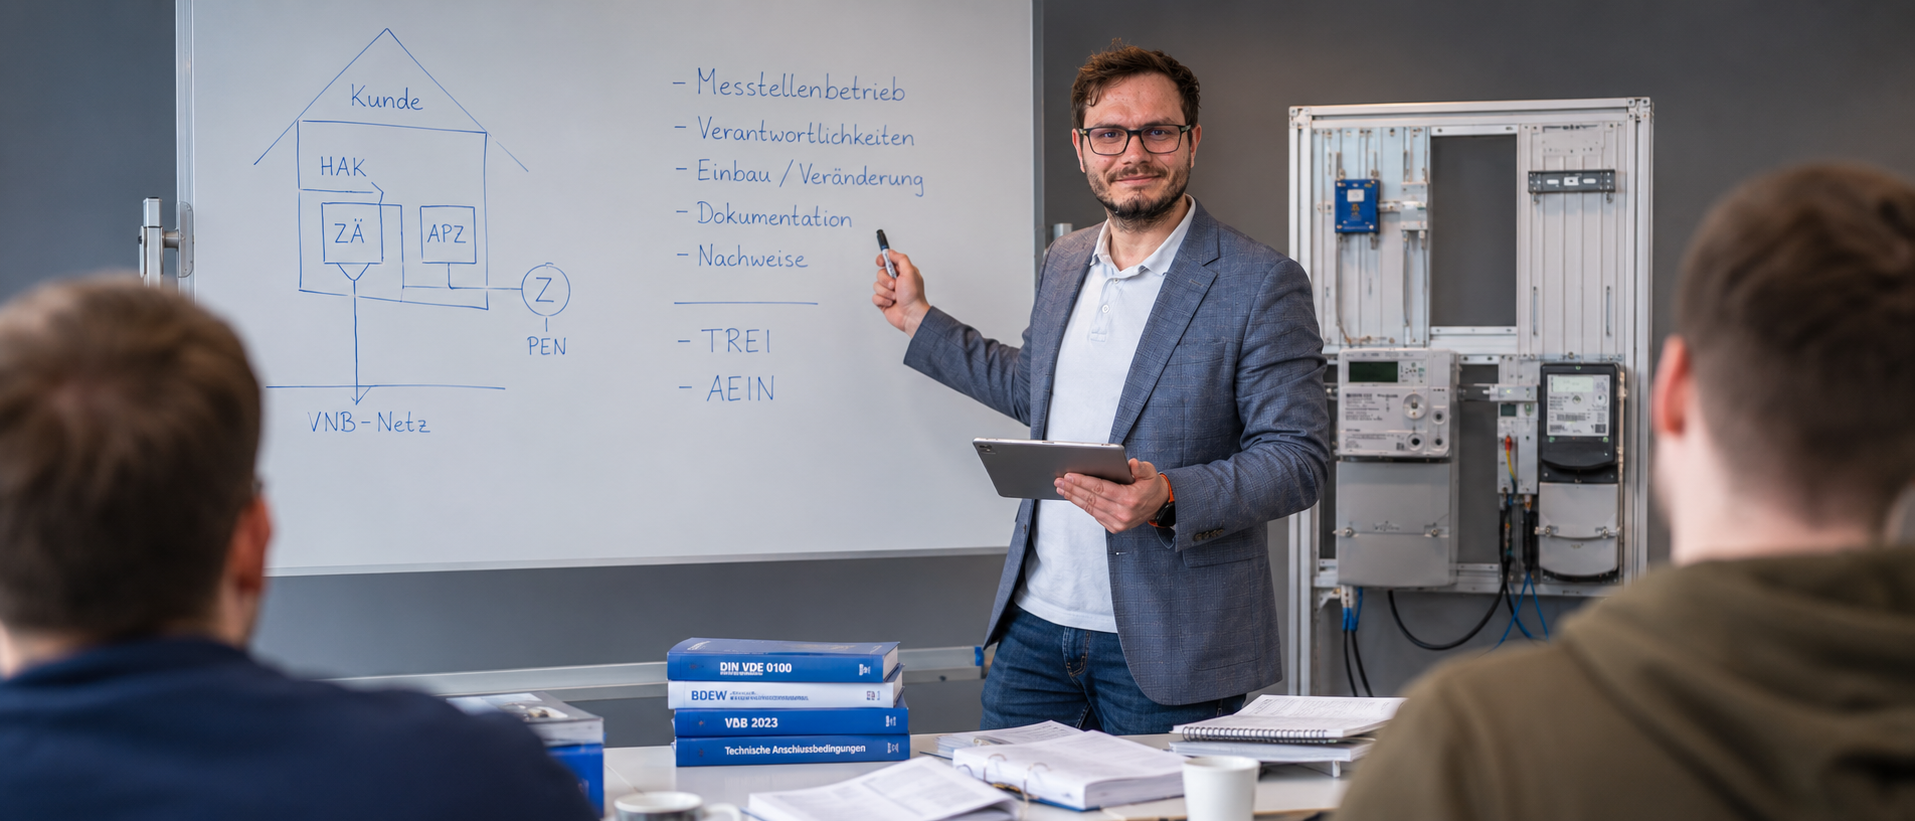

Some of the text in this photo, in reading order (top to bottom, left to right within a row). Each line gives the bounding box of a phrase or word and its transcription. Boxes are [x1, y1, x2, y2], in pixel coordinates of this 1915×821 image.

[351, 83, 424, 111] Kunde
[697, 67, 906, 102] Messtellenbetrieb
[697, 116, 915, 147] Verantwortlichkeiten
[320, 155, 367, 178] HAK
[697, 158, 772, 183] Einbau
[798, 162, 925, 198] Veränderung
[696, 200, 853, 228] Dokumentation
[333, 217, 365, 244] ZÄ
[426, 223, 467, 244] APZ
[698, 243, 809, 268] Nachweise
[534, 276, 555, 304] Z
[526, 335, 567, 356] PEN
[701, 327, 771, 354] TREI
[706, 374, 775, 403] AEIN
[720, 662, 792, 673] DIN VDE 0100
[691, 690, 728, 701] BDEW
[751, 717, 778, 728] 2023
[725, 745, 771, 756] Technische
